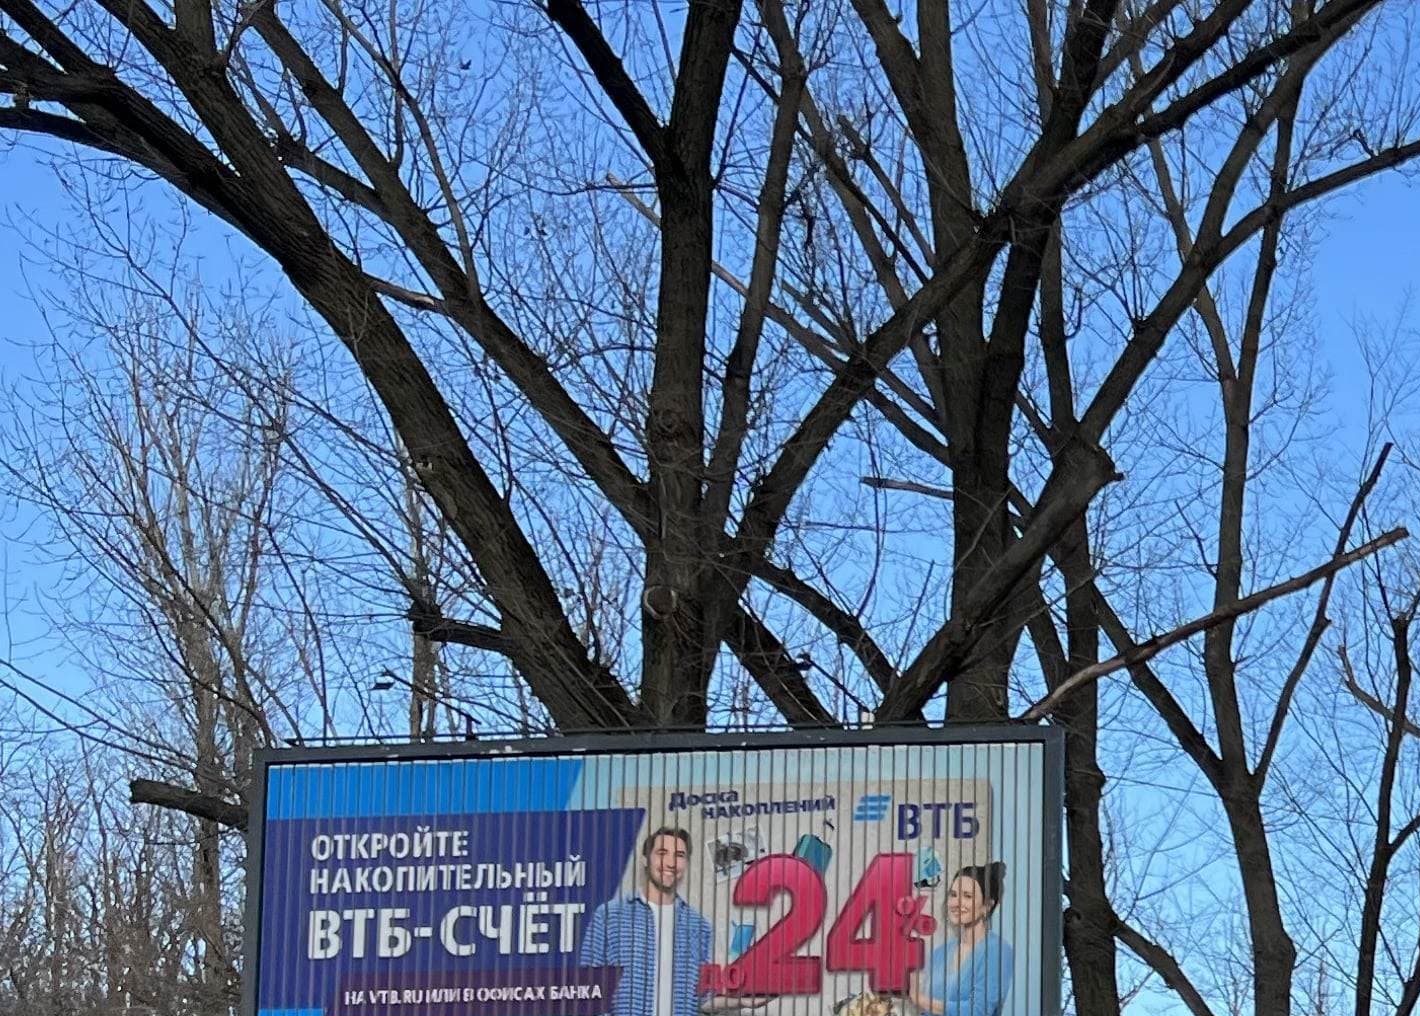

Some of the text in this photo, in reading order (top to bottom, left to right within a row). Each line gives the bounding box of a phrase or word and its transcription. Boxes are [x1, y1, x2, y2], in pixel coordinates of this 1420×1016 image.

[898, 802, 980, 840] ВТБ
[311, 826, 468, 861] ОТКРОЙТЕ
[310, 855, 586, 894] НАКОПИТЕЛЬНЫЙ
[308, 892, 586, 960] ВТБ-СЧЁТ
[345, 991, 366, 1006] НА
[550, 985, 602, 1000] БАНКА
